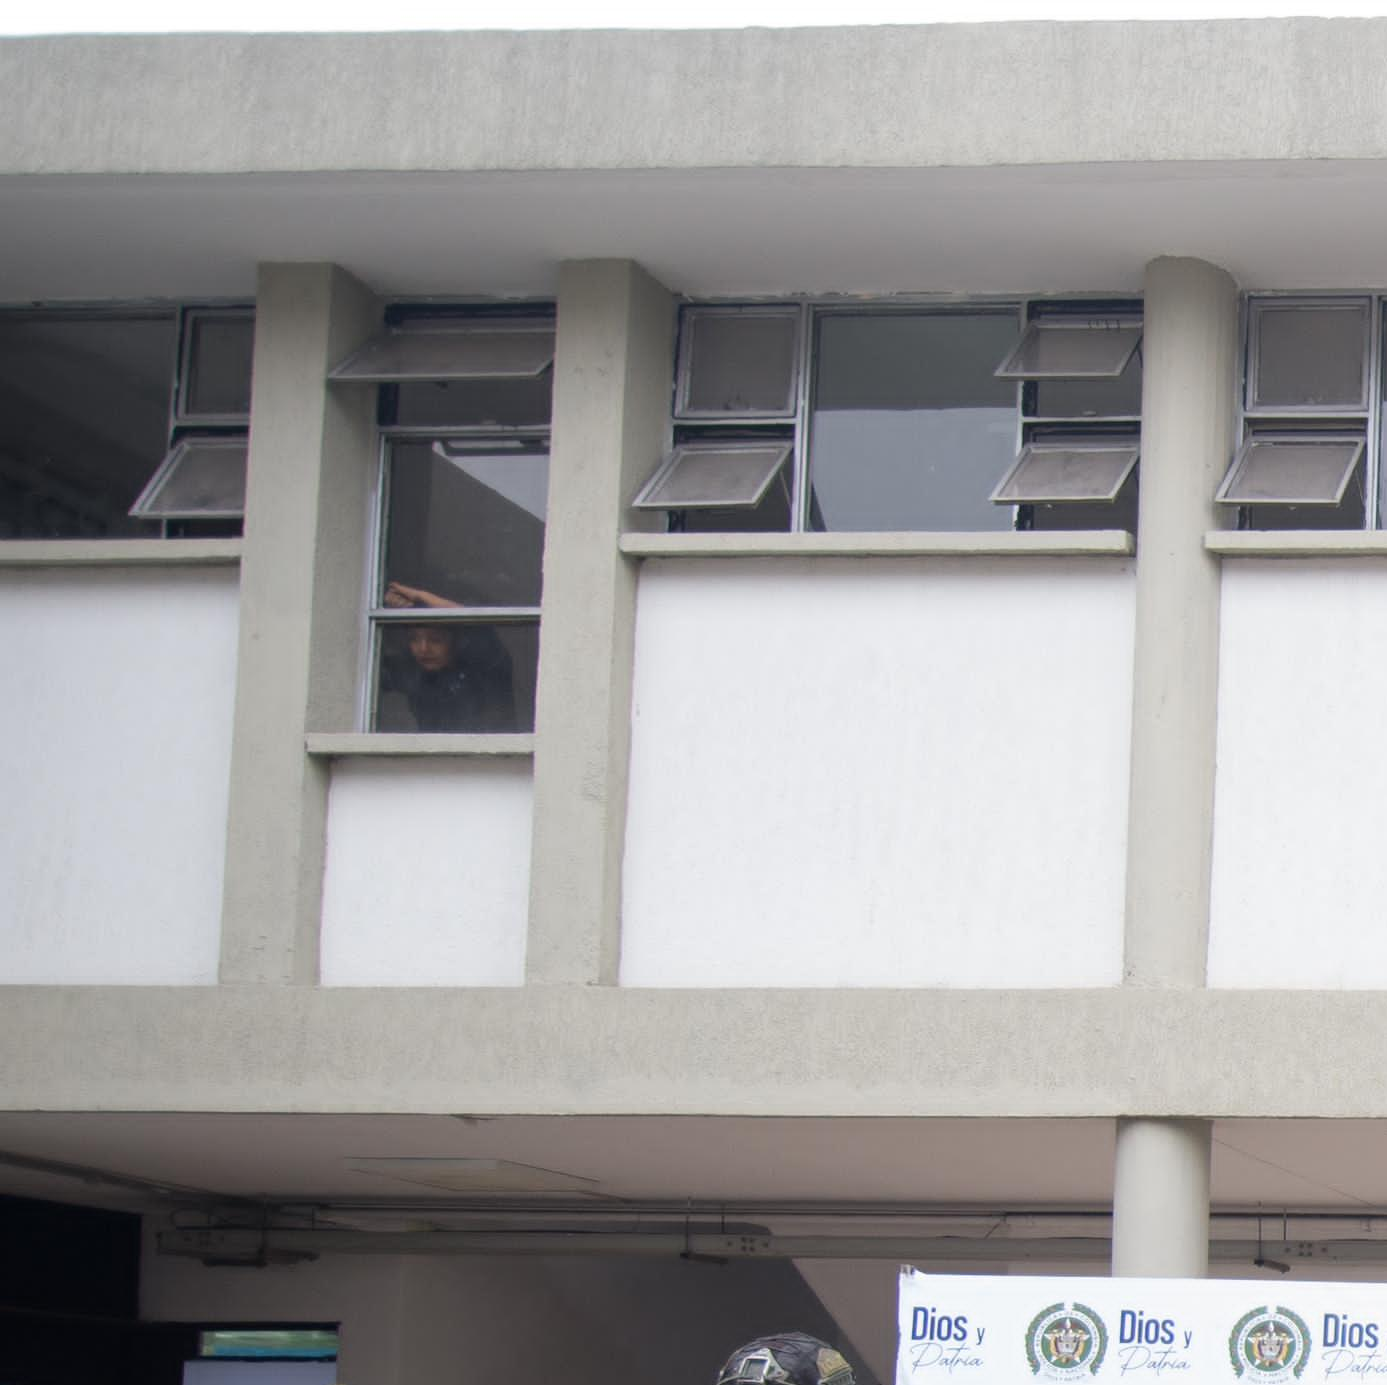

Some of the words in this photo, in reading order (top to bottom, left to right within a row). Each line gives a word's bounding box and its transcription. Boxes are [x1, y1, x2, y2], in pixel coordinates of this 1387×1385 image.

[911, 1307, 967, 1341] Dios
[976, 1328, 985, 1345] y
[1120, 1310, 1174, 1344] Dios
[1184, 1331, 1192, 1349] y
[1323, 1313, 1378, 1348] Dios
[910, 1341, 983, 1374] Patria
[1118, 1343, 1190, 1376] Patria
